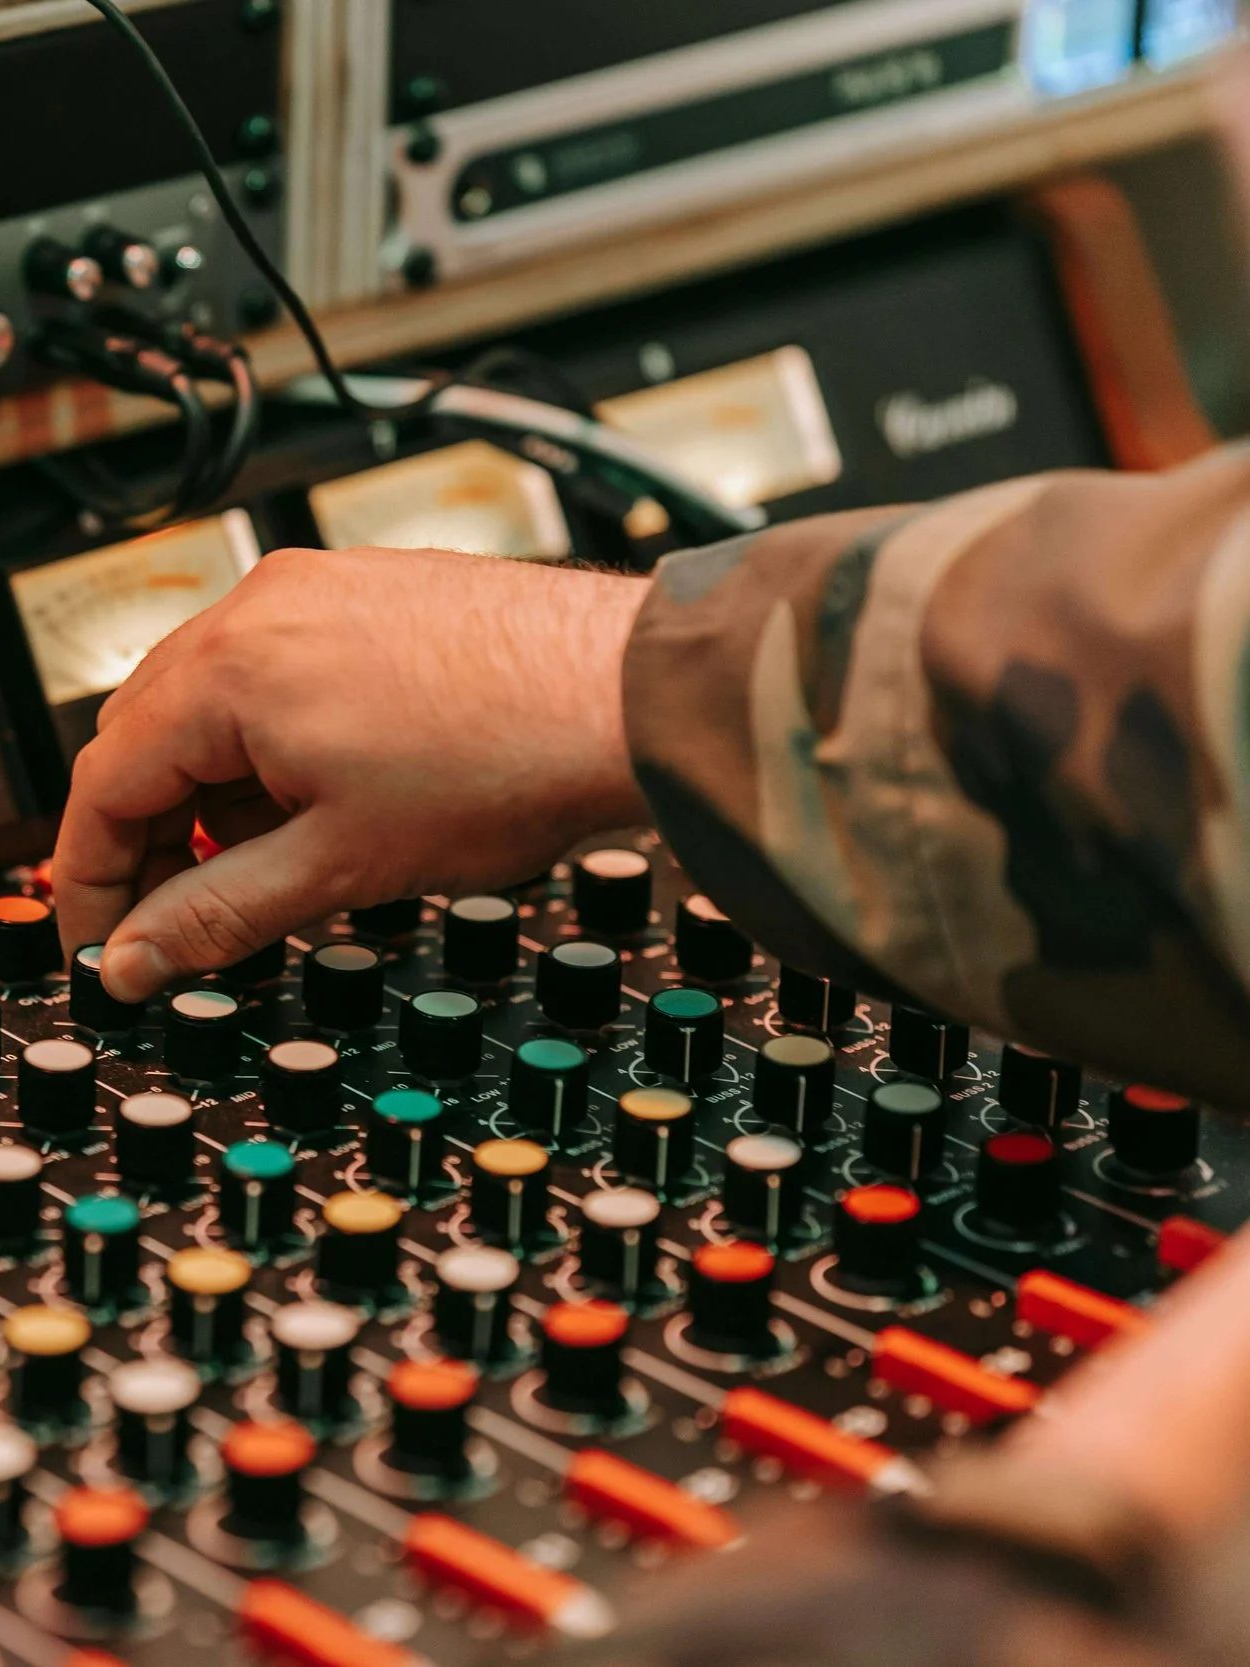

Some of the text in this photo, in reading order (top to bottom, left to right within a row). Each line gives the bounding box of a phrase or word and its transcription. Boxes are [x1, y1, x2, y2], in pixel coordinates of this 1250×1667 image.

[371, 1040, 398, 1052] MID
[609, 1039, 639, 1052] LOW
[982, 1070, 1001, 1079] 12
[230, 1091, 256, 1104] MID
[470, 1089, 502, 1103] LOW
[705, 1087, 742, 1104] BUSS
[950, 1085, 985, 1101] BUSS
